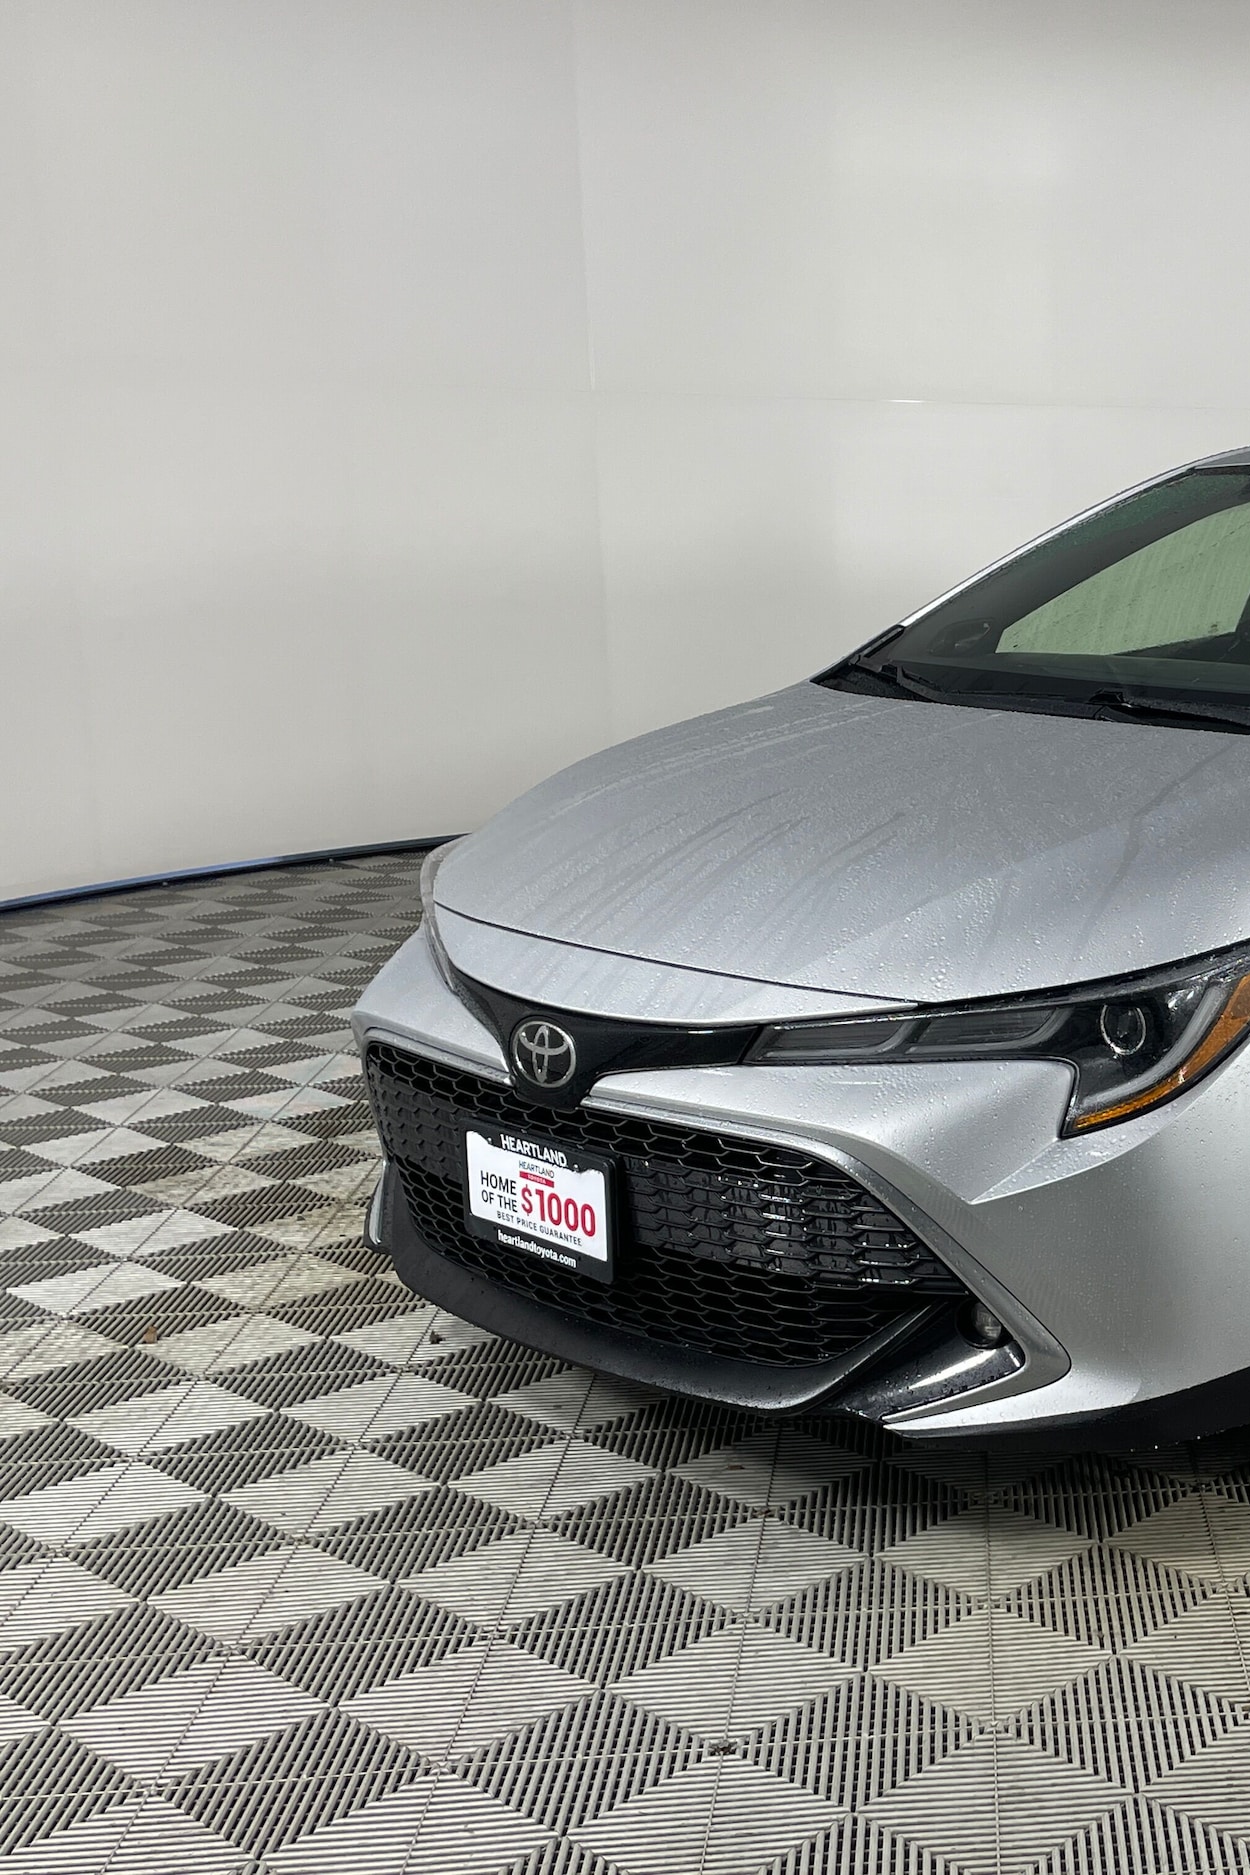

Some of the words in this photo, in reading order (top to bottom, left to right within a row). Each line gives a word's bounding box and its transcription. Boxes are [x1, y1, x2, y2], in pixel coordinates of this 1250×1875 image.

[500, 1133, 567, 1168] HEARTLAND
[480, 1170, 517, 1196] HOME
[518, 1160, 555, 1179] HEARTLAND
[481, 1189, 495, 1205] OF
[497, 1194, 518, 1213] THE
[521, 1184, 596, 1237] $1000
[496, 1210, 515, 1223] BEST
[517, 1217, 537, 1231] PRICE
[539, 1225, 582, 1246] GUARANTEE
[497, 1229, 577, 1269] heartlandtoyota.com
